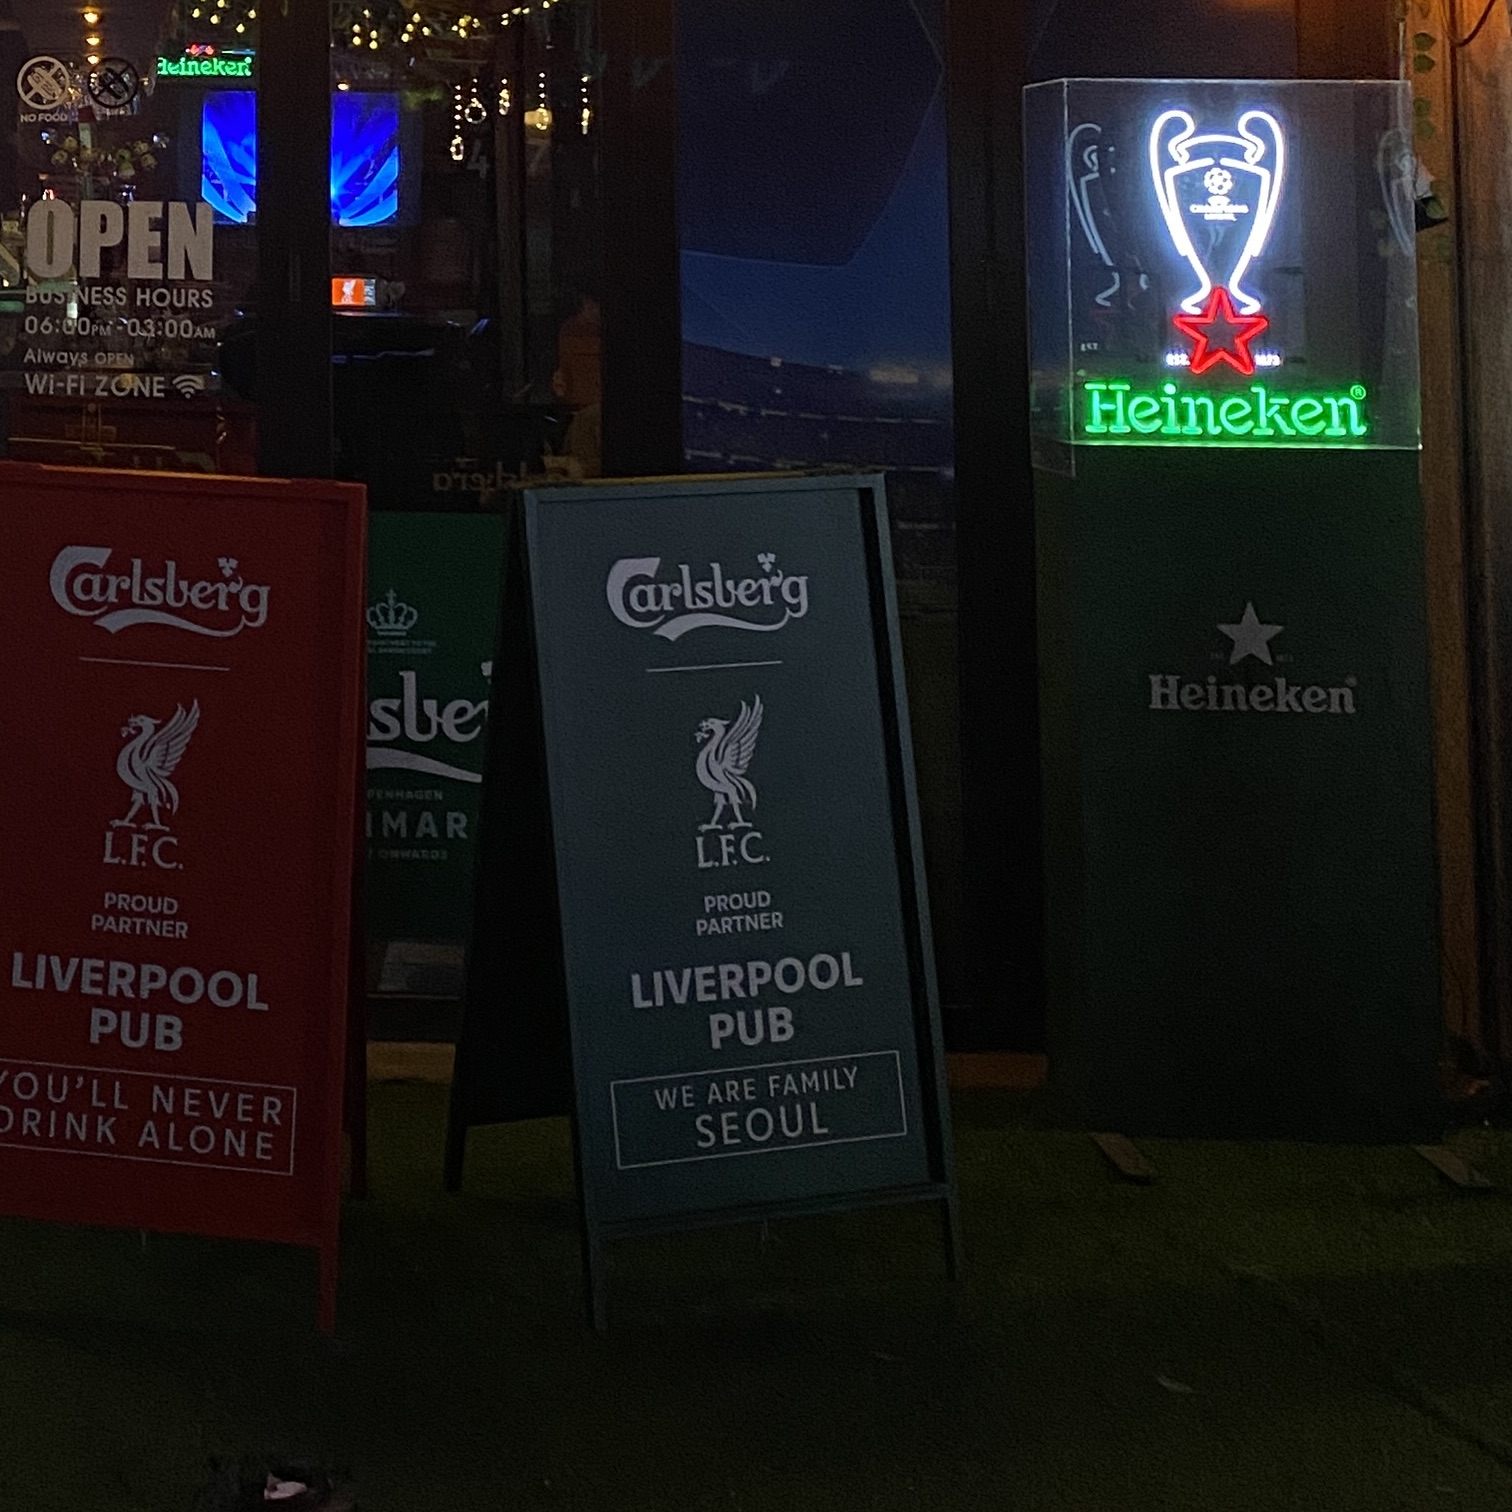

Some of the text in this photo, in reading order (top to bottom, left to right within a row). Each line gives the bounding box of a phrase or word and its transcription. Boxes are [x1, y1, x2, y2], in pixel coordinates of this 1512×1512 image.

[20, 112, 37, 123] NO
[26, 197, 215, 281] OPEN
[136, 287, 214, 308] HOURS
[23, 347, 135, 367] Always OPEN
[94, 375, 166, 398] ZONE
[49, 544, 272, 638] Carlsberg
[606, 556, 809, 642] Carlsberg
[1148, 674, 1357, 715] Heineken
[103, 831, 184, 870] L.F.C.
[695, 831, 771, 869] L.F.C.
[104, 891, 179, 916] PROUD
[704, 890, 772, 914] PROUD
[91, 913, 189, 939] PARTNER
[696, 911, 784, 937] PARTNER
[11, 952, 270, 1012] LIVERPOOL
[631, 952, 864, 1009] LIVERPOOL
[89, 1007, 184, 1052] PUB
[709, 1006, 795, 1050] PUB
[152, 1084, 283, 1126] NEVER
[654, 1065, 859, 1111] WE ARE FAMILY
[138, 1119, 274, 1161] ALONE
[695, 1101, 829, 1149] SEOUL
